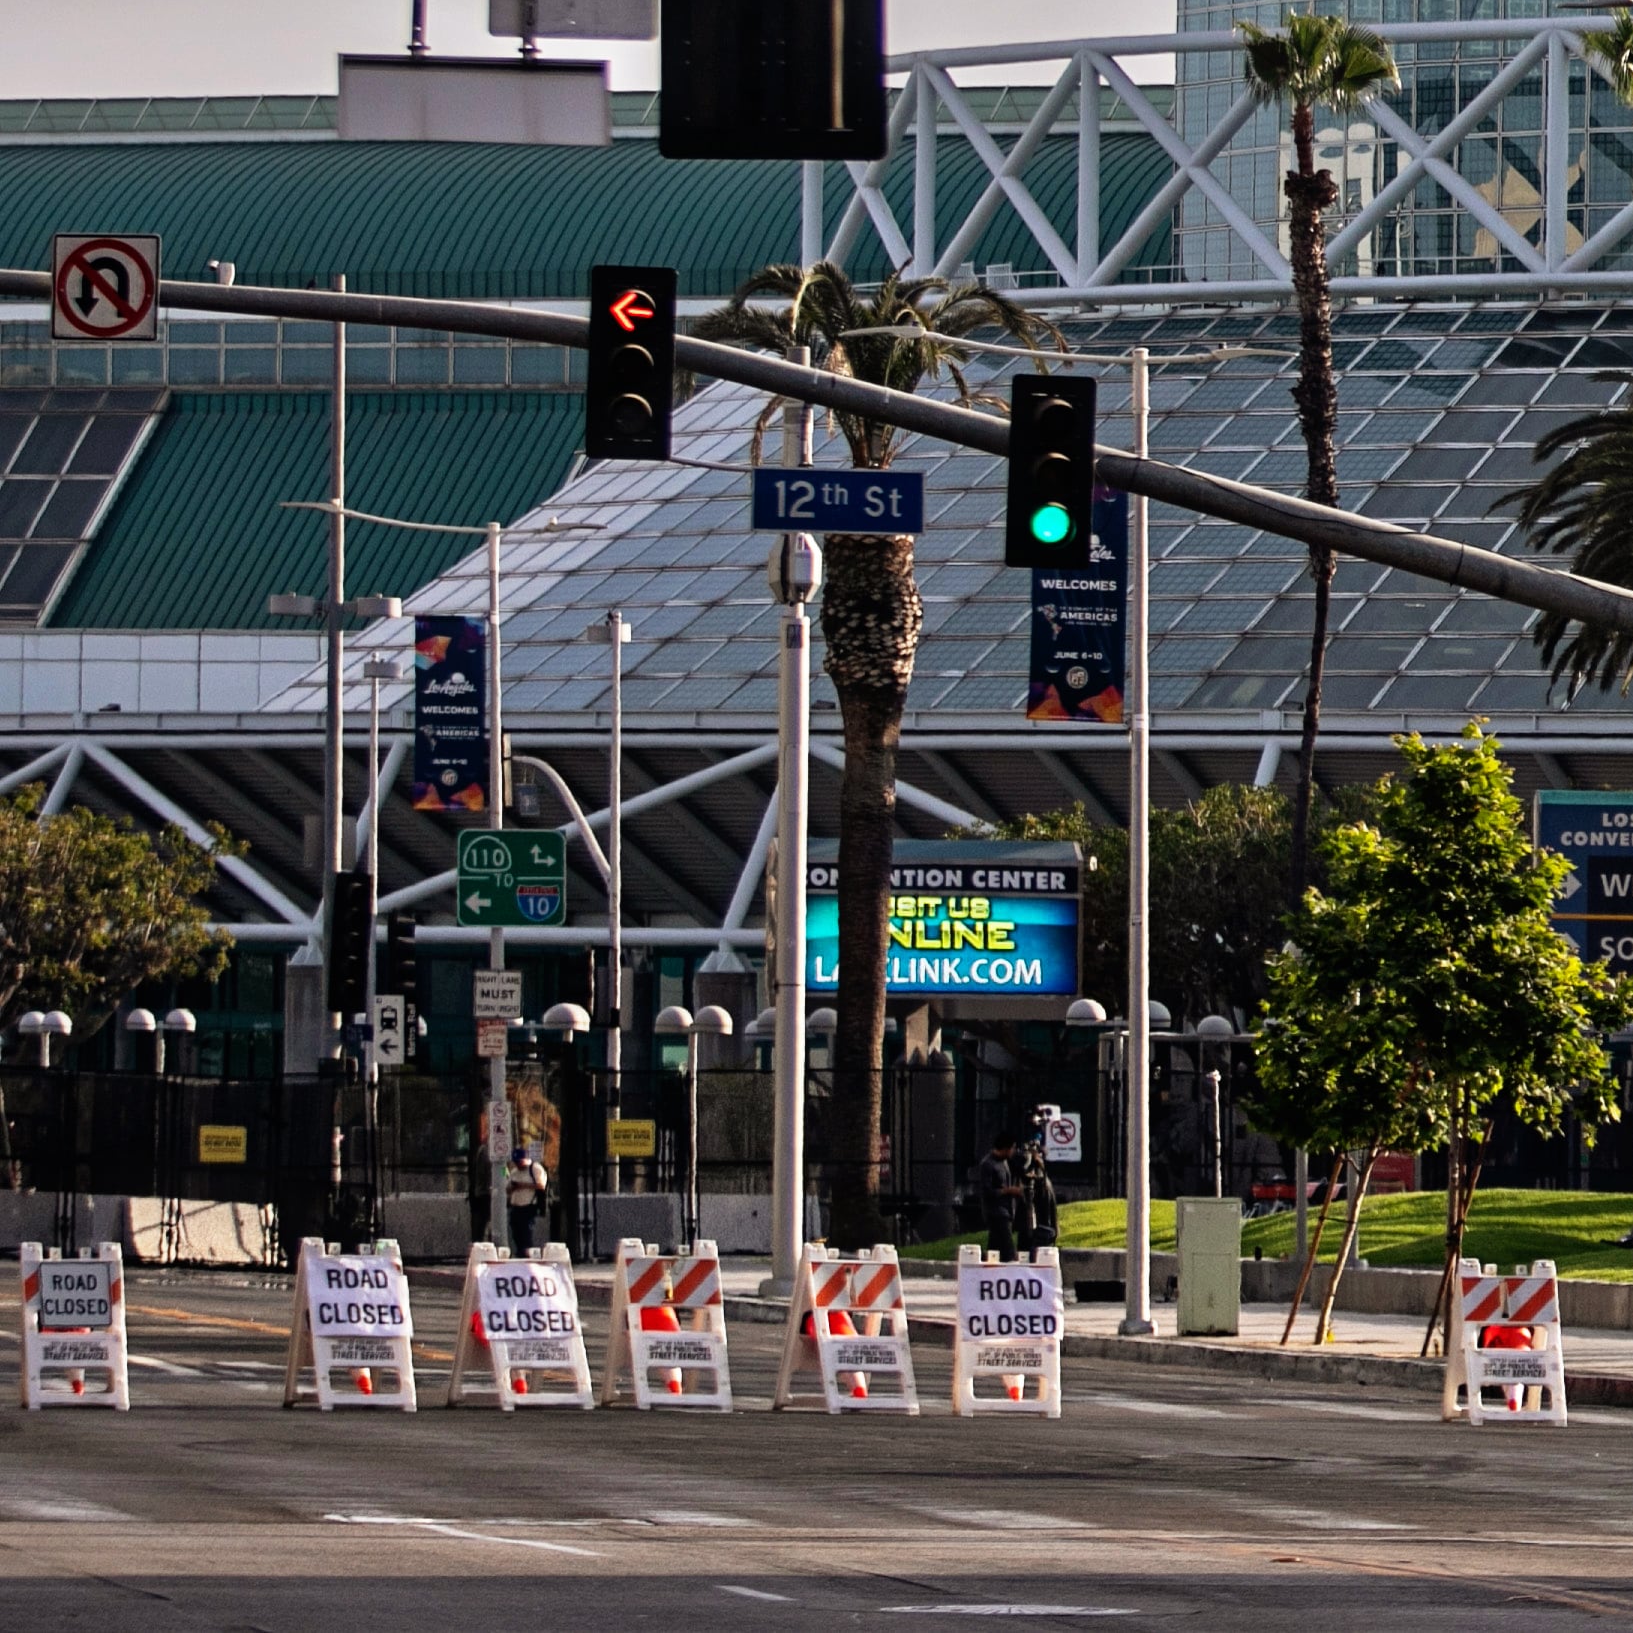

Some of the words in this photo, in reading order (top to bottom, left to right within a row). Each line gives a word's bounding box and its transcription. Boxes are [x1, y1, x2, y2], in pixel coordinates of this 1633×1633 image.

[774, 481, 850, 518] 12th
[864, 487, 902, 517] St
[1041, 579, 1117, 591] WELCOMES
[1060, 612, 1118, 622] AMERICAS
[422, 706, 478, 714] WELCOMES
[471, 850, 504, 867] 110
[494, 873, 513, 888] TO
[973, 870, 1066, 890] CENTER
[528, 897, 549, 916] 10
[888, 896, 942, 917] ISIT
[948, 897, 990, 918] US
[888, 920, 1014, 950] NLINE
[481, 989, 515, 999] MUST
[52, 1274, 97, 1291] ROAD
[327, 1269, 388, 1289] ROAD
[495, 1276, 557, 1298] ROAD
[980, 1279, 1043, 1301] ROAD
[44, 1298, 108, 1316] CLOSED
[319, 1303, 403, 1325] CLOSED
[488, 1310, 574, 1332] CLOSED
[969, 1314, 1056, 1336] CLOSED
[650, 1352, 677, 1360] STREET
[678, 1352, 711, 1360] SERVICES
[838, 1356, 863, 1364] STREET
[865, 1356, 896, 1364] SERVICES
[1006, 1359, 1041, 1368] SERVICES
[1512, 1369, 1546, 1378] SERVICES
